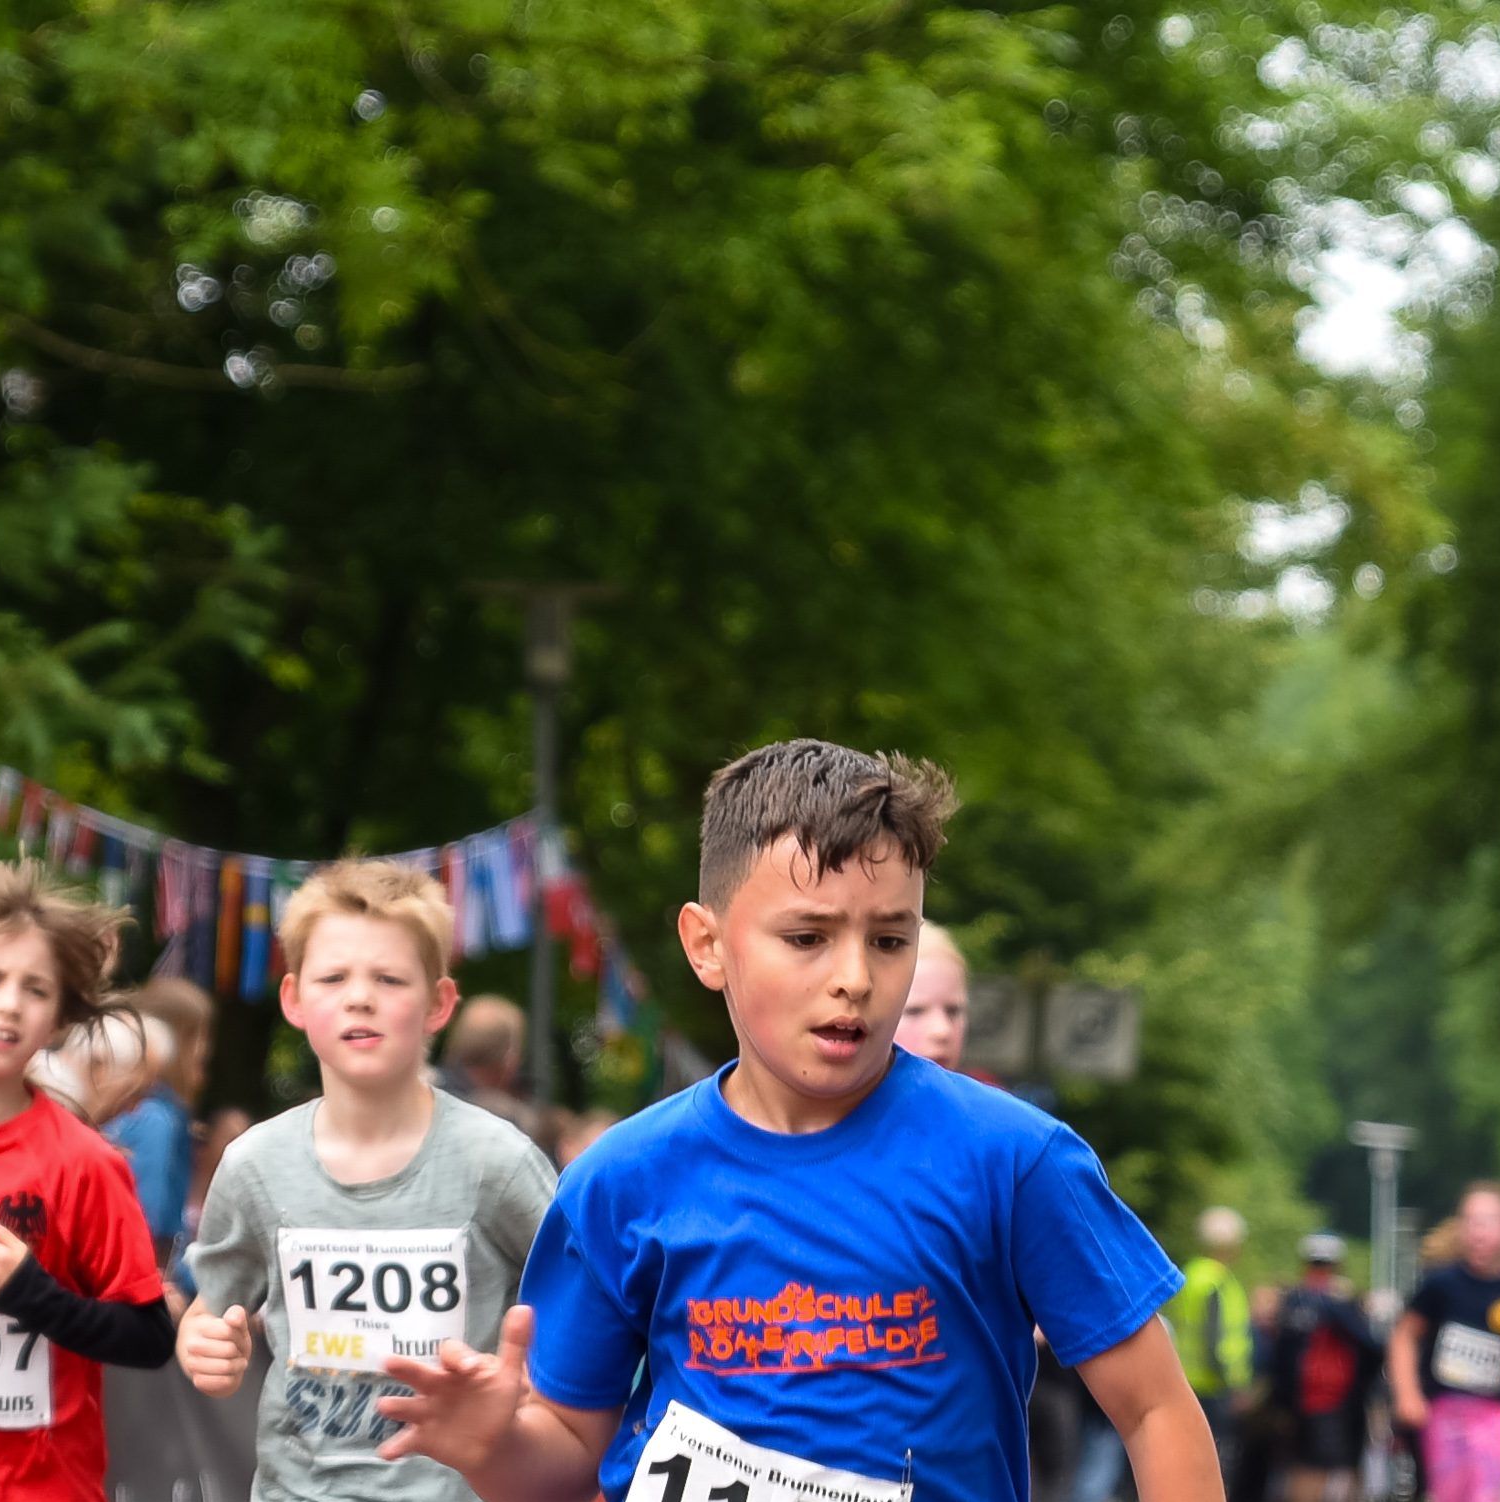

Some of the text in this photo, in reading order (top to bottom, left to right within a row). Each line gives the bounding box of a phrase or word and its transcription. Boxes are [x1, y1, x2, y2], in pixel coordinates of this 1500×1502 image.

[290, 1258, 461, 1313] 1208
[354, 1318, 390, 1330] Thies
[693, 1292, 915, 1326] GRUNDSCHULE
[306, 1332, 451, 1359] EWE brun
[670, 1424, 762, 1478] Everstener
